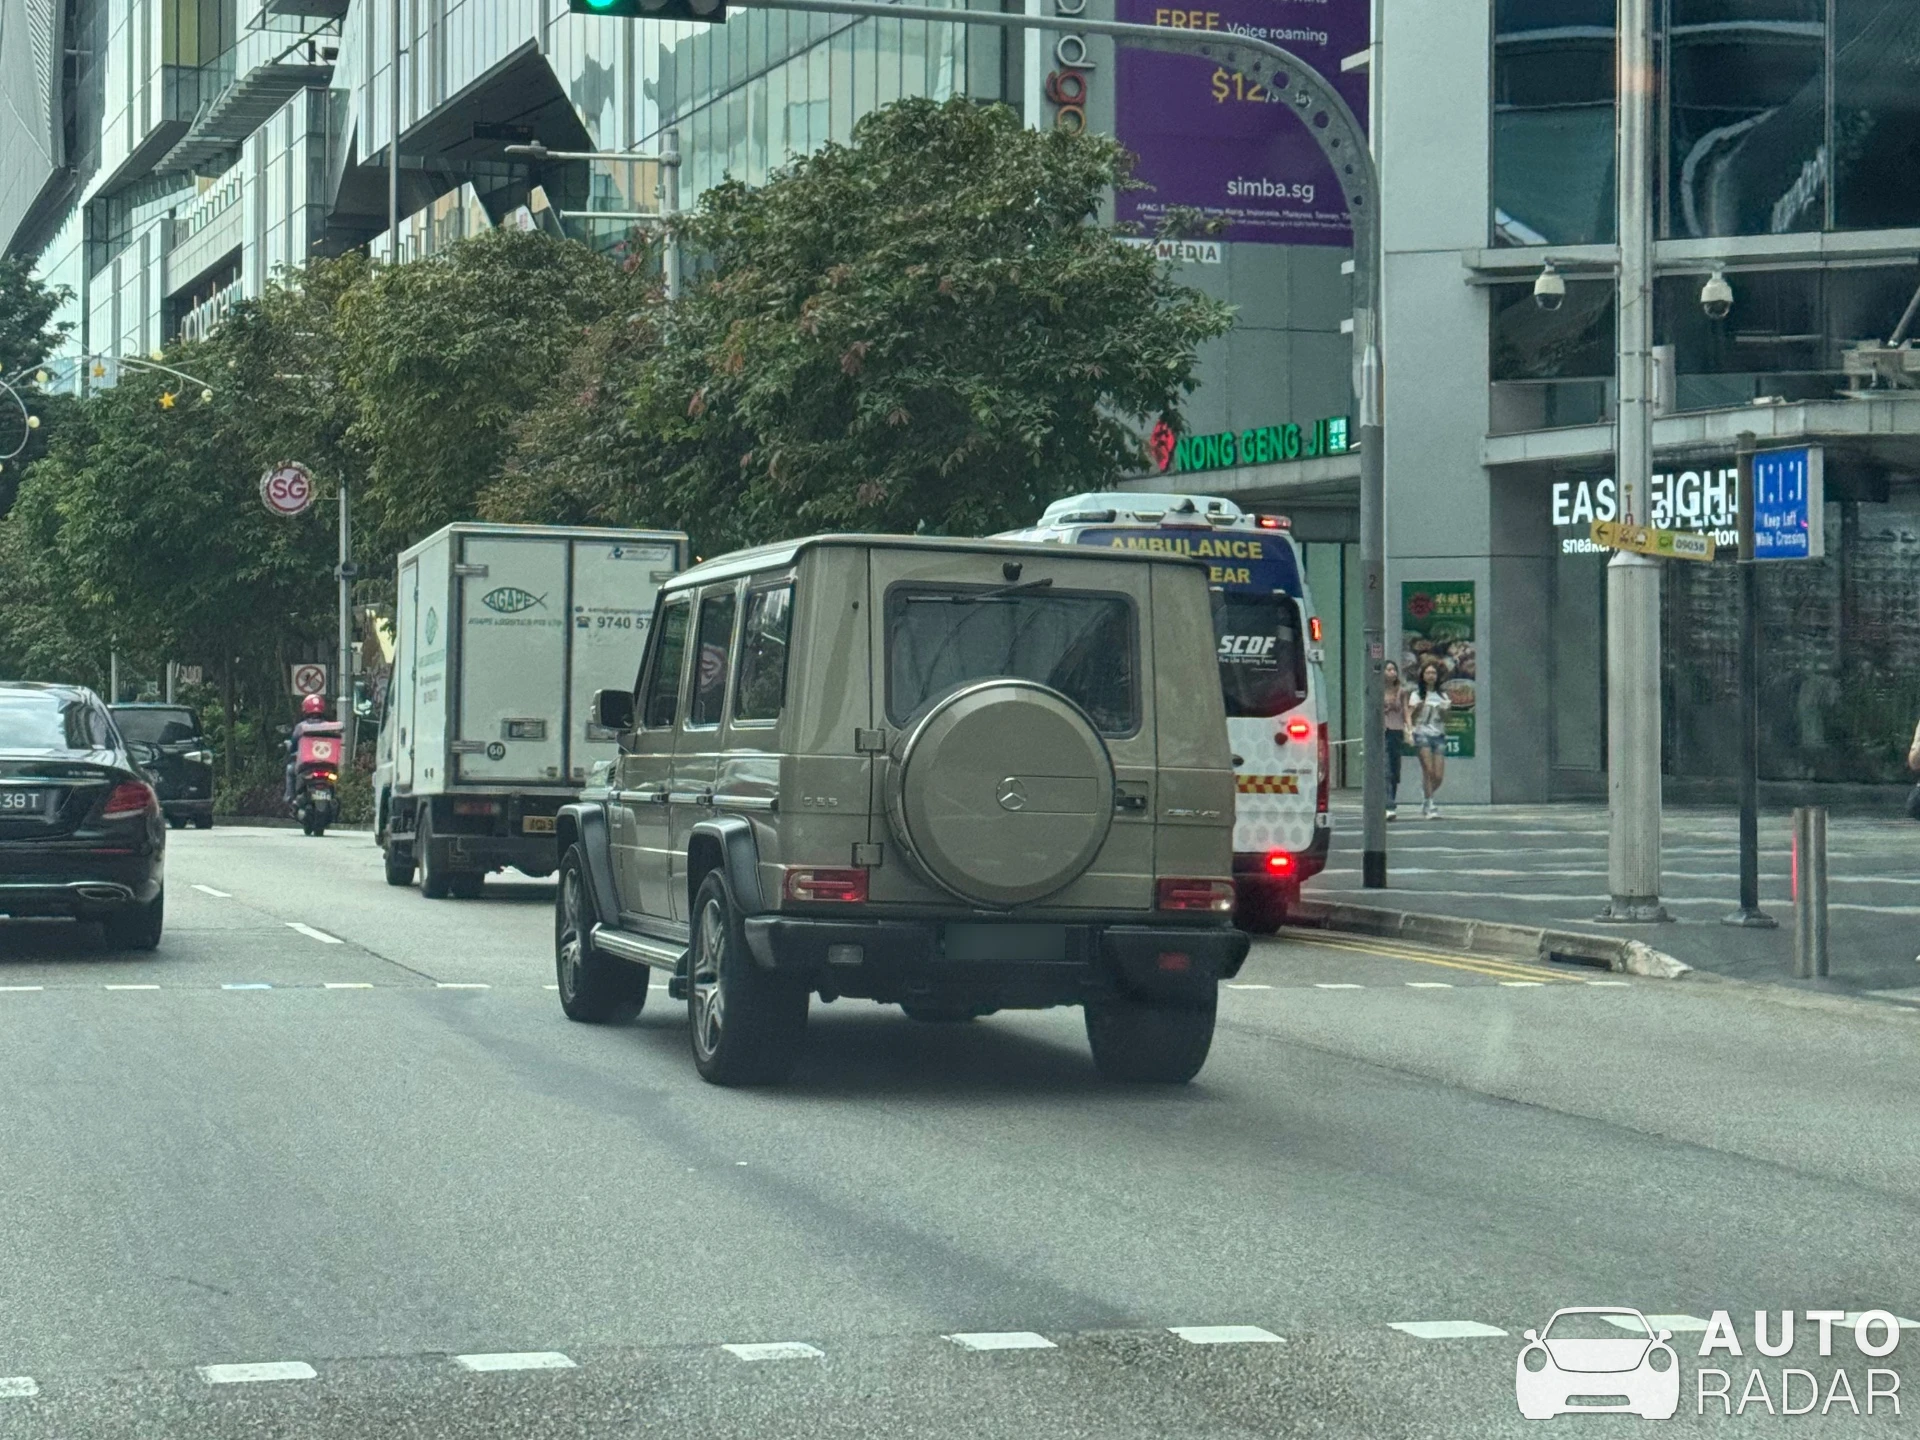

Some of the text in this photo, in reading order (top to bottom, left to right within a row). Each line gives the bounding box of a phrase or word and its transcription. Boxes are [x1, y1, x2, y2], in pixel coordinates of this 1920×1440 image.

[1156, 9, 1328, 45] FREE Voice roaming
[1227, 177, 1314, 203] simba.sg
[1159, 243, 1217, 261] MEDIA
[1176, 420, 1325, 471] NONG GENG JI
[272, 478, 307, 499] SG
[1764, 510, 1797, 529] Keep Left
[1111, 537, 1263, 559] AMBULANCE
[1756, 530, 1806, 548] While Crossing
[1369, 574, 1377, 590] 2
[489, 588, 532, 611] AGAPE
[597, 616, 631, 629] 9740
[1217, 635, 1277, 654] SCDF
[489, 744, 504, 756] 60
[0, 793, 40, 809] 38T
